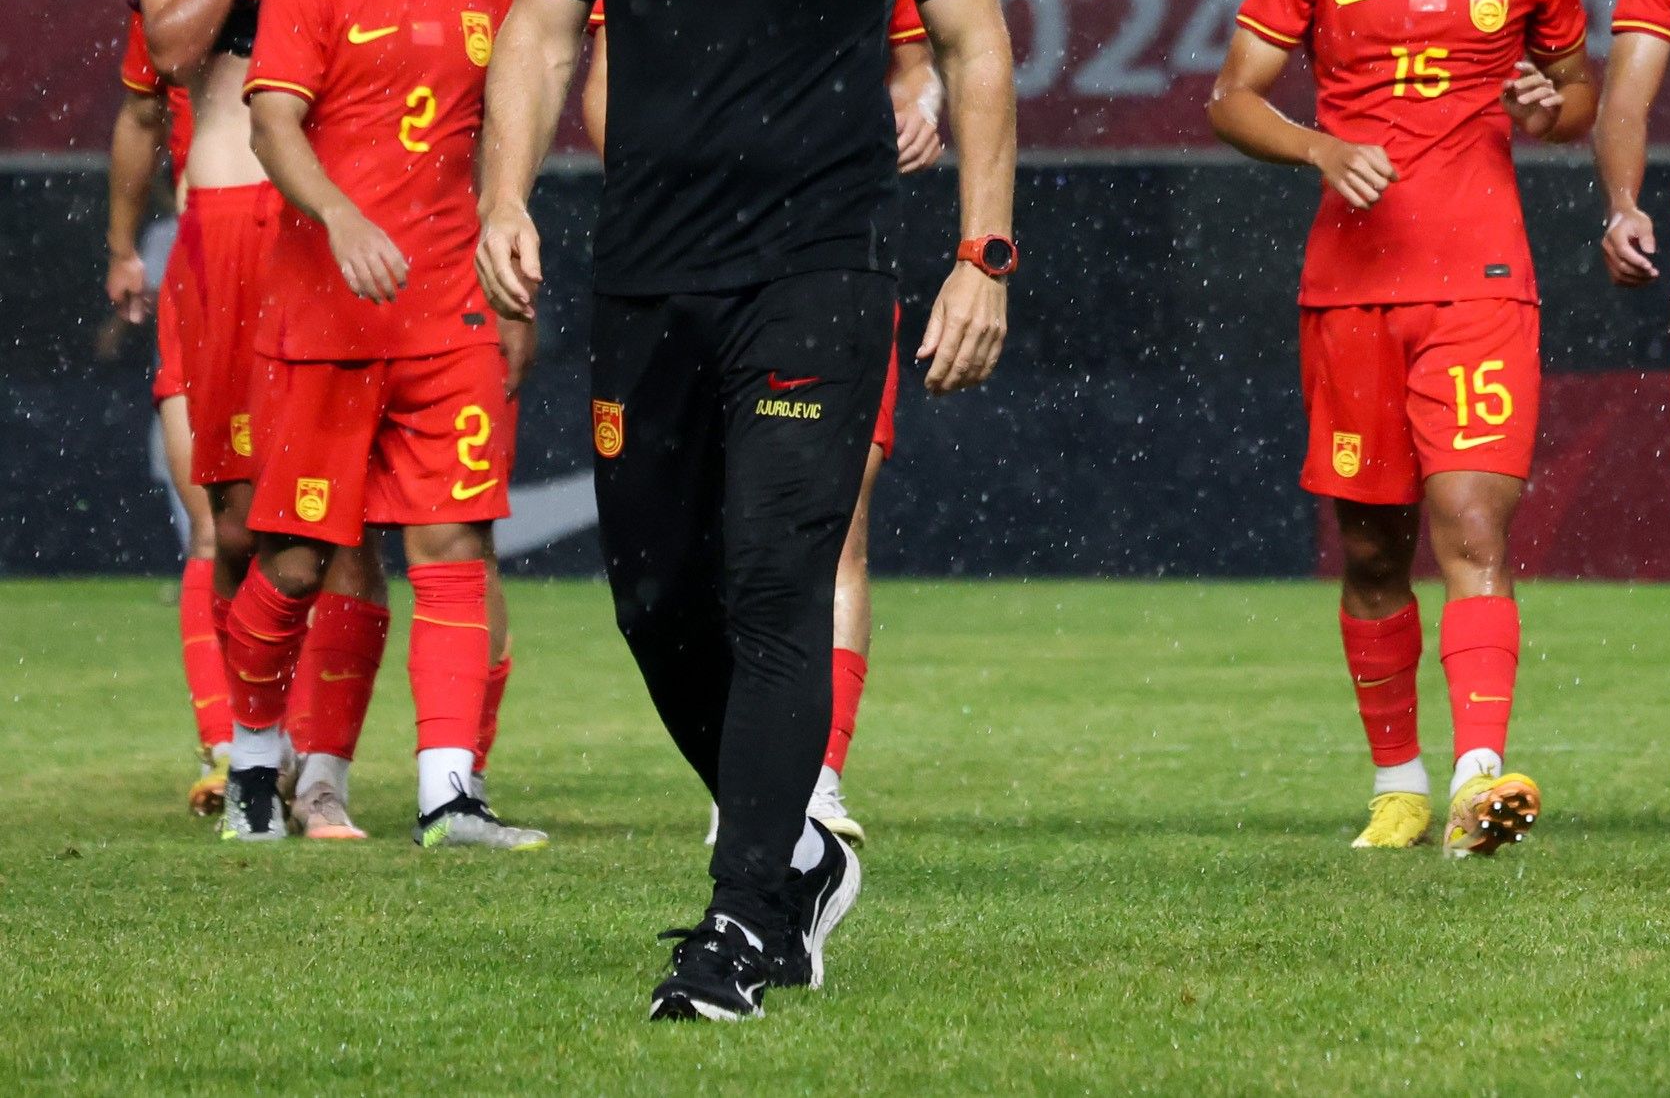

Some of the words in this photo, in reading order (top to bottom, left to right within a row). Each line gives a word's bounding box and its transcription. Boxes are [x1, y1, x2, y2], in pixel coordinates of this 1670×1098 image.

[1391, 46, 1451, 98] 15
[399, 86, 437, 152] 2
[756, 400, 822, 419] DJURDJEVIC
[1448, 360, 1513, 426] 15
[455, 405, 491, 471] 2
